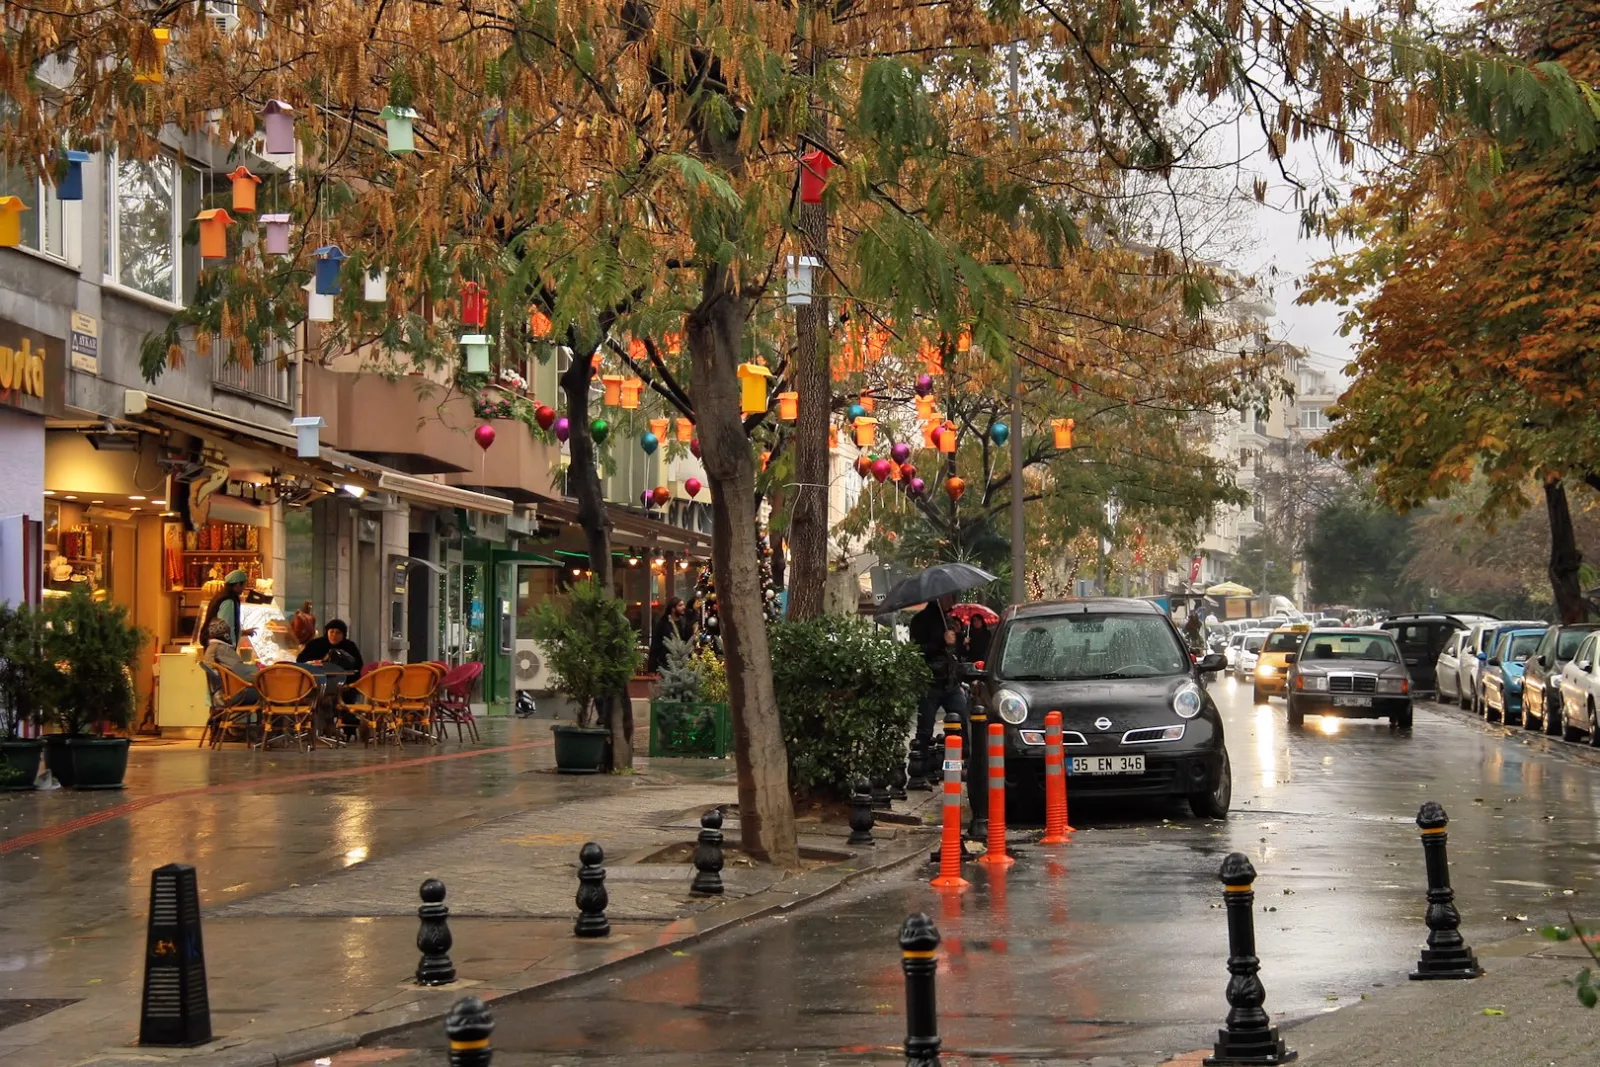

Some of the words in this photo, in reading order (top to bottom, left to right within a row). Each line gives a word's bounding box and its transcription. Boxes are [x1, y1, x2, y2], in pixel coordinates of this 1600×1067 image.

[1074, 759, 1088, 771] 35
[1098, 758, 1112, 770] EN
[1121, 757, 1142, 769] 346
